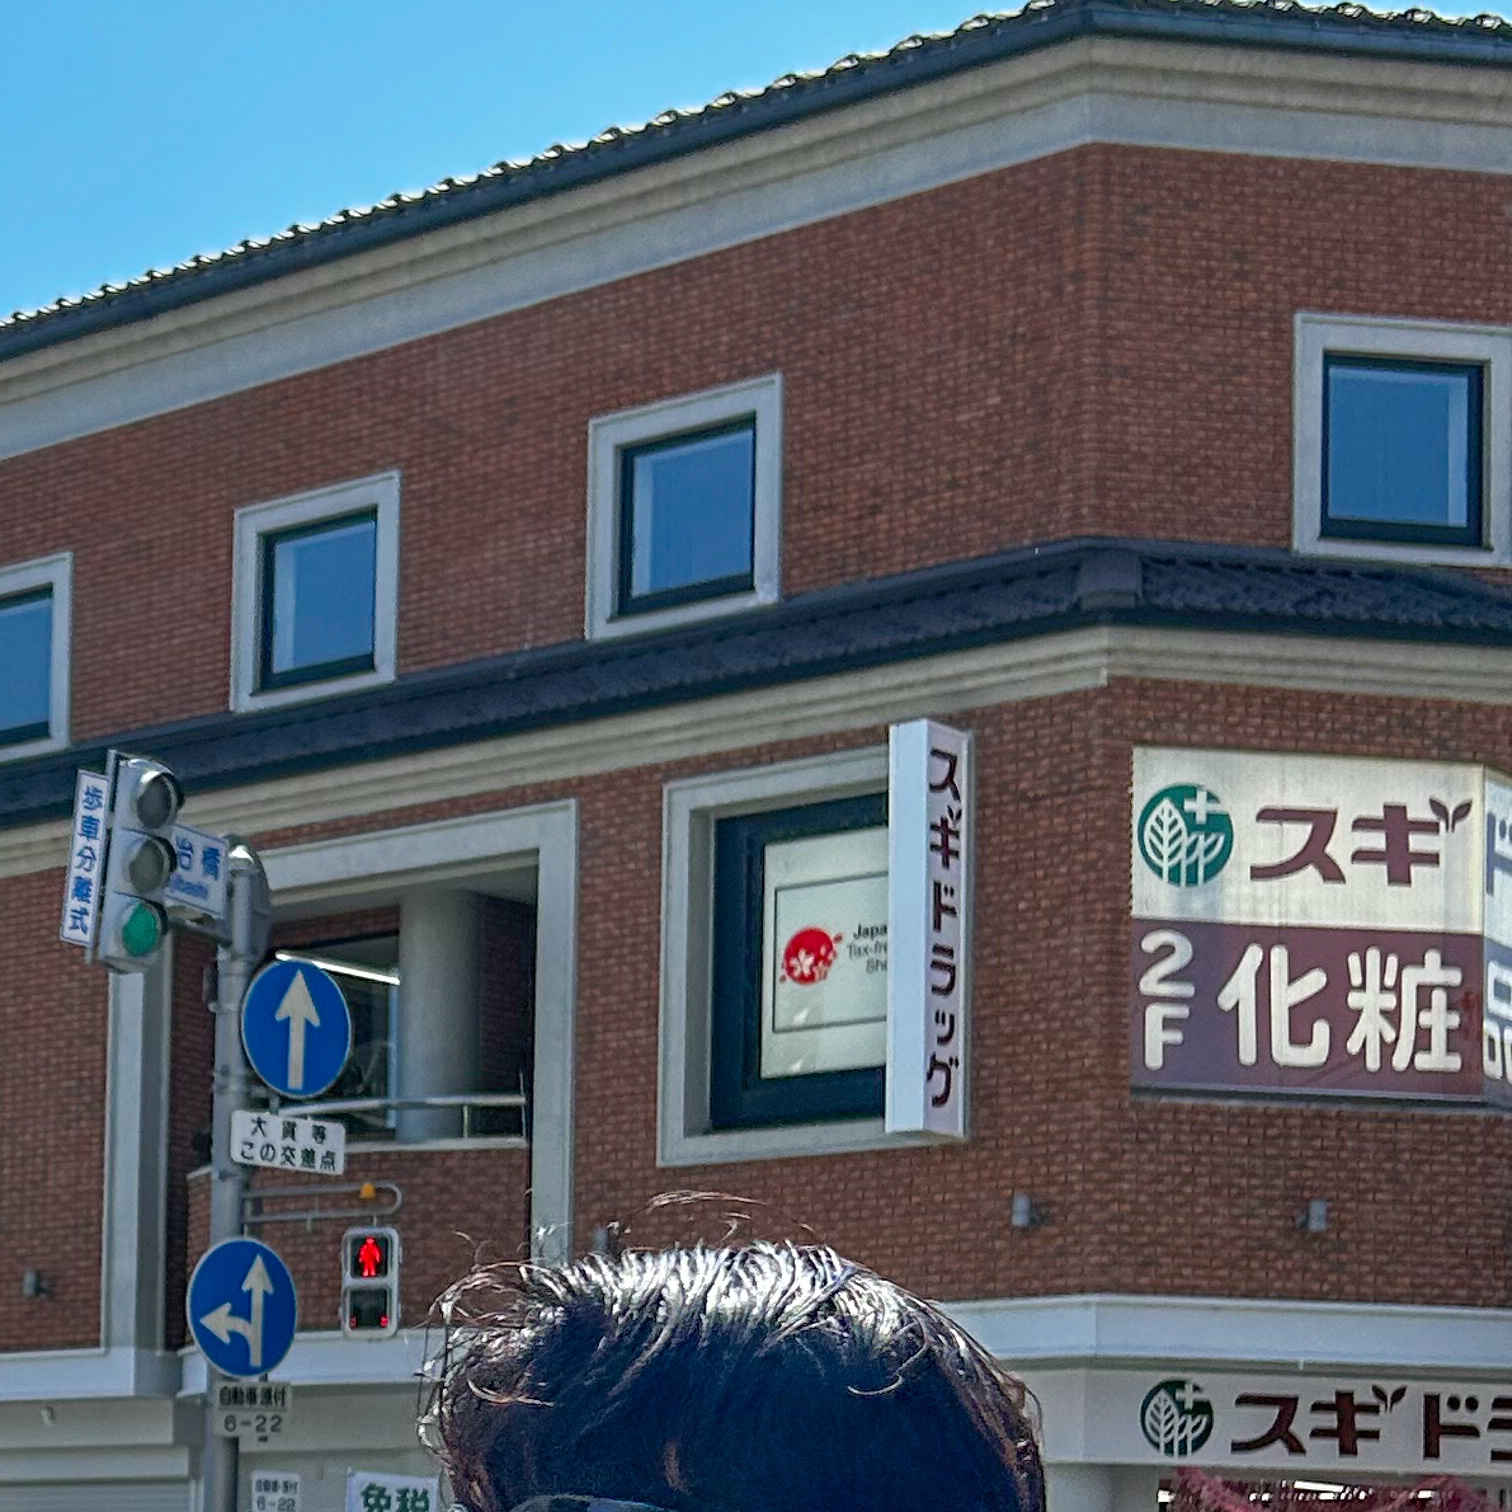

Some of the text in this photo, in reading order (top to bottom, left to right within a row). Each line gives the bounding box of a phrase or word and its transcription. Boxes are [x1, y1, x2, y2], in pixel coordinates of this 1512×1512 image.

[926, 748, 962, 1109] スギドラッグ
[241, 1141, 336, 1172] この交差点
[224, 1414, 282, 1432] 6-22
[257, 1496, 296, 1512] 6-22
